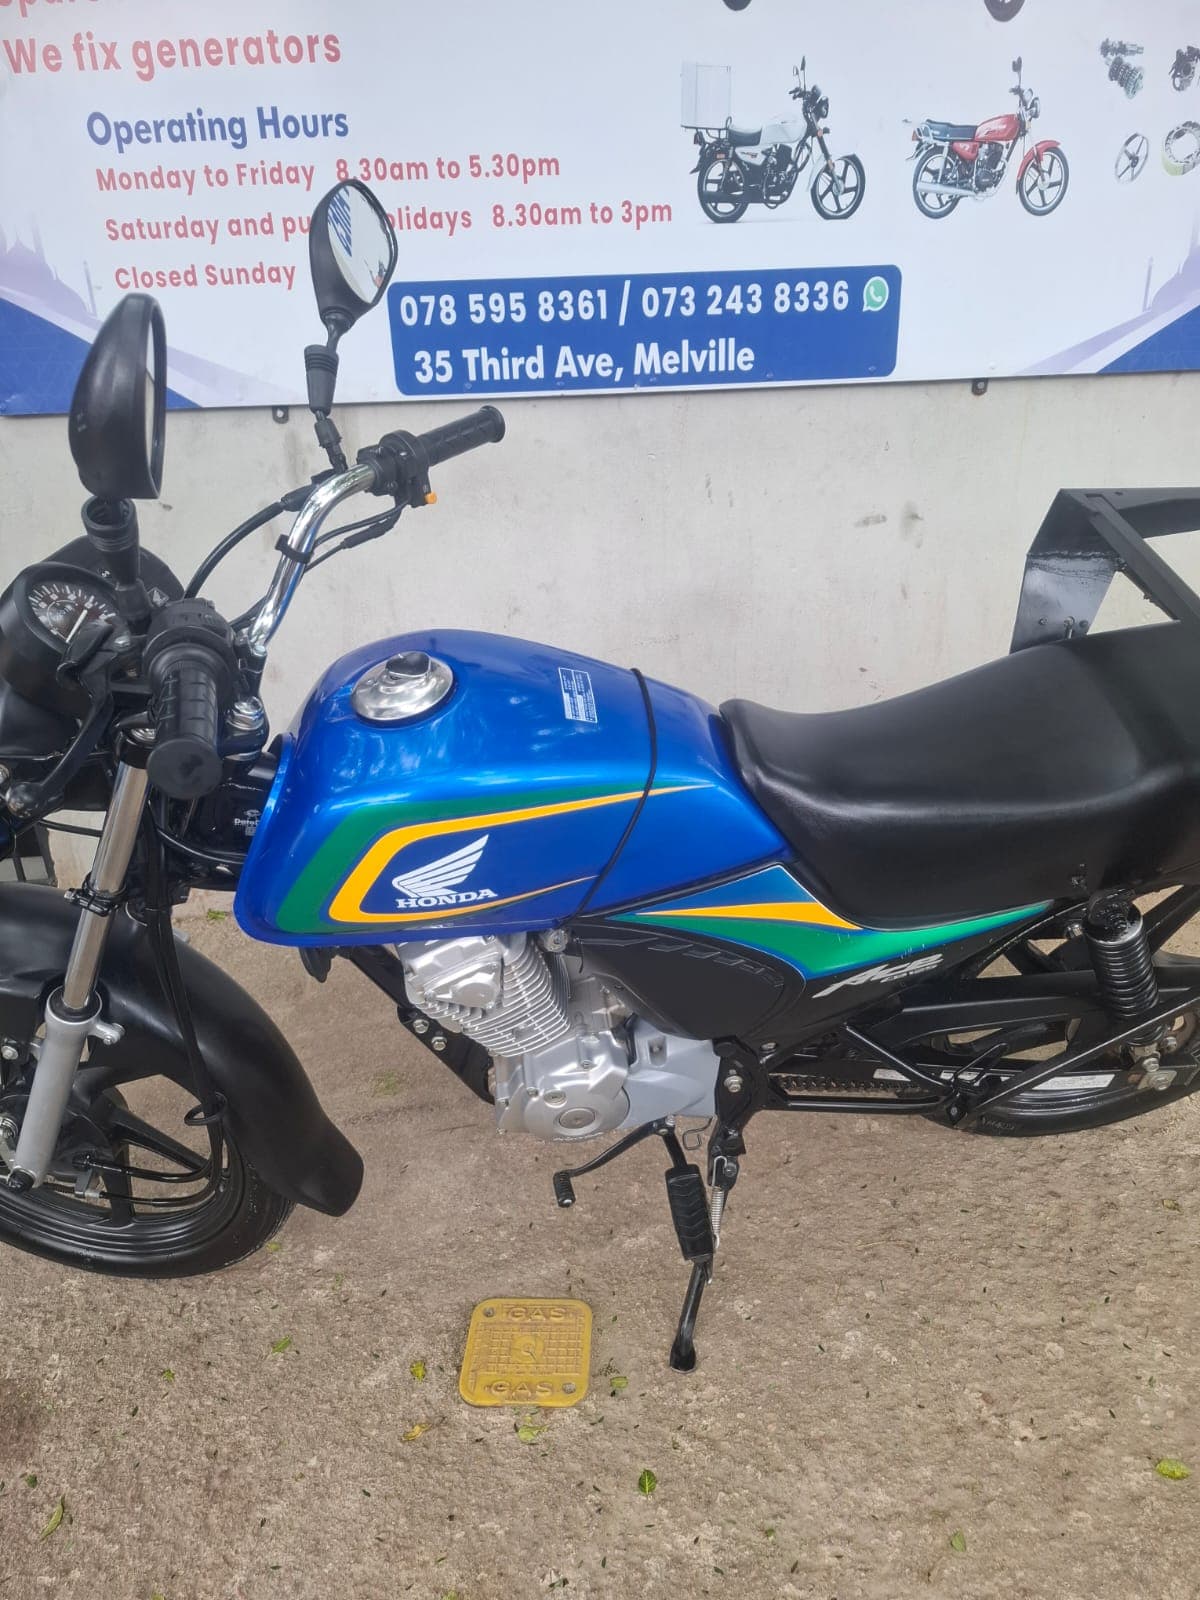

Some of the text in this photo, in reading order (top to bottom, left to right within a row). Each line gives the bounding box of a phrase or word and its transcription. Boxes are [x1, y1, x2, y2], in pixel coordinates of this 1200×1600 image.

[3, 29, 341, 82] We fix generators
[87, 106, 349, 153] Operating Hours
[96, 165, 195, 195] Monday
[204, 165, 229, 187] to
[236, 160, 315, 191] Friday
[437, 157, 461, 179] to
[468, 153, 561, 184] 5.30pm
[105, 215, 219, 245] Saturday
[227, 212, 274, 238] and
[386, 205, 473, 236] lidays
[492, 203, 582, 228] 8.30am
[589, 203, 613, 224] to
[621, 199, 673, 230] 3pm
[115, 261, 296, 290] Closed Sunday
[400, 279, 849, 327] 078 595 8361 / 073 243 8336
[414, 337, 755, 384] 35 Third Ave, Melville
[396, 888, 498, 908] HONDA
[508, 1307, 567, 1322] GAS
[490, 1380, 554, 1397] GAS
